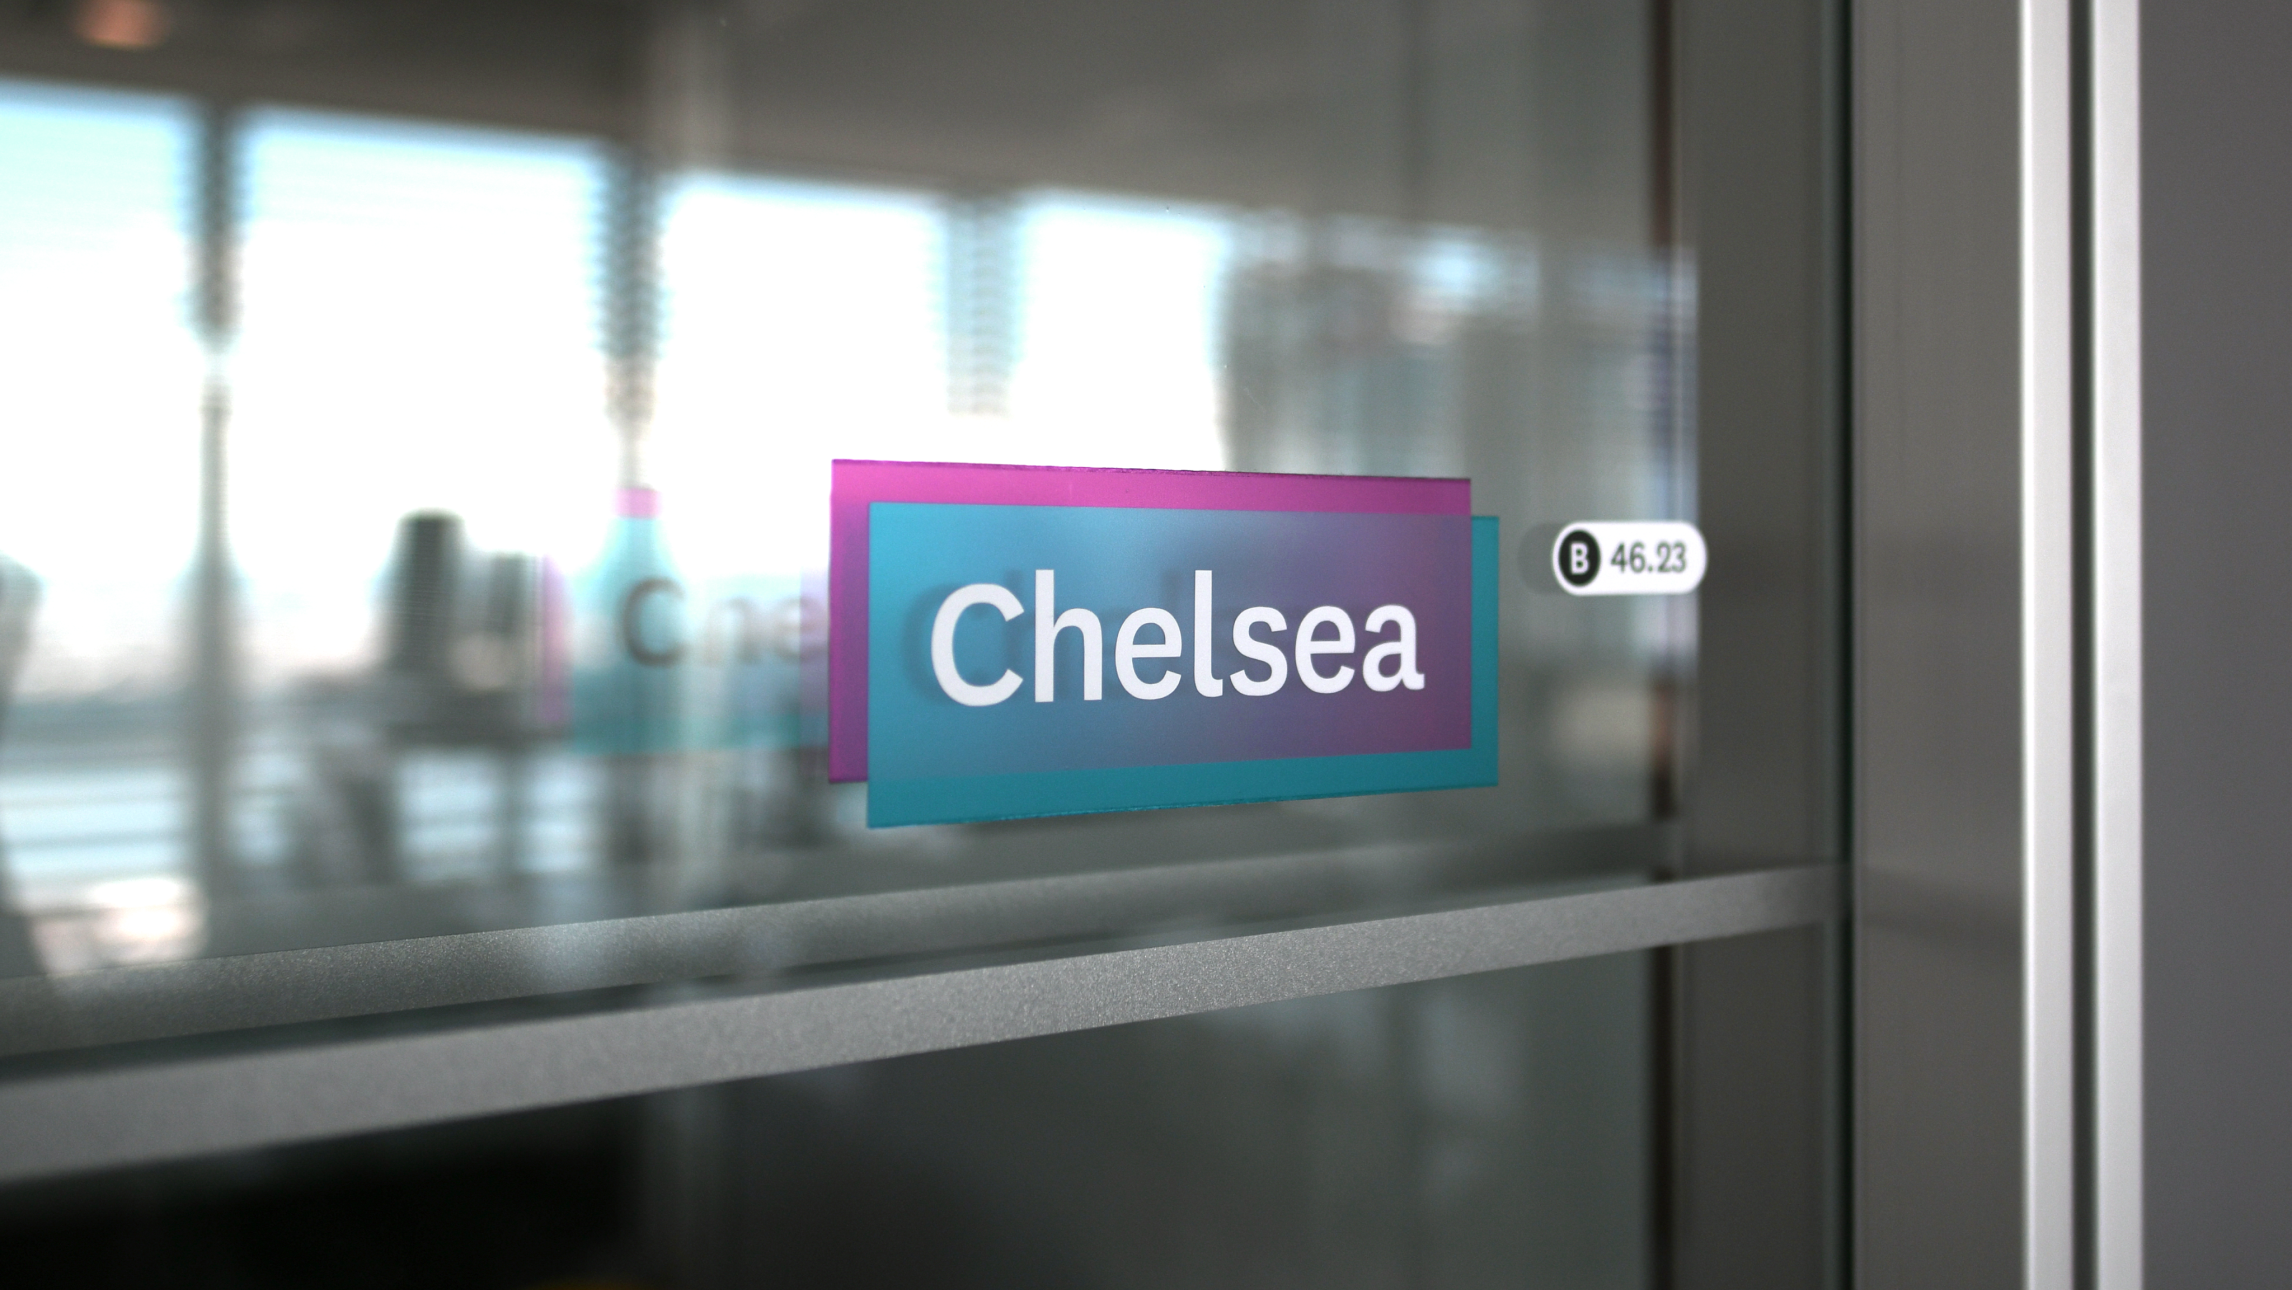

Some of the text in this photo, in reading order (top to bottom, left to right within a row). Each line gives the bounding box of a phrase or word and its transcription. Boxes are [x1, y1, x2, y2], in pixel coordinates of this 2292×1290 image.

[1571, 541, 1687, 574] B 46.23
[930, 569, 1425, 708] Chelsea
